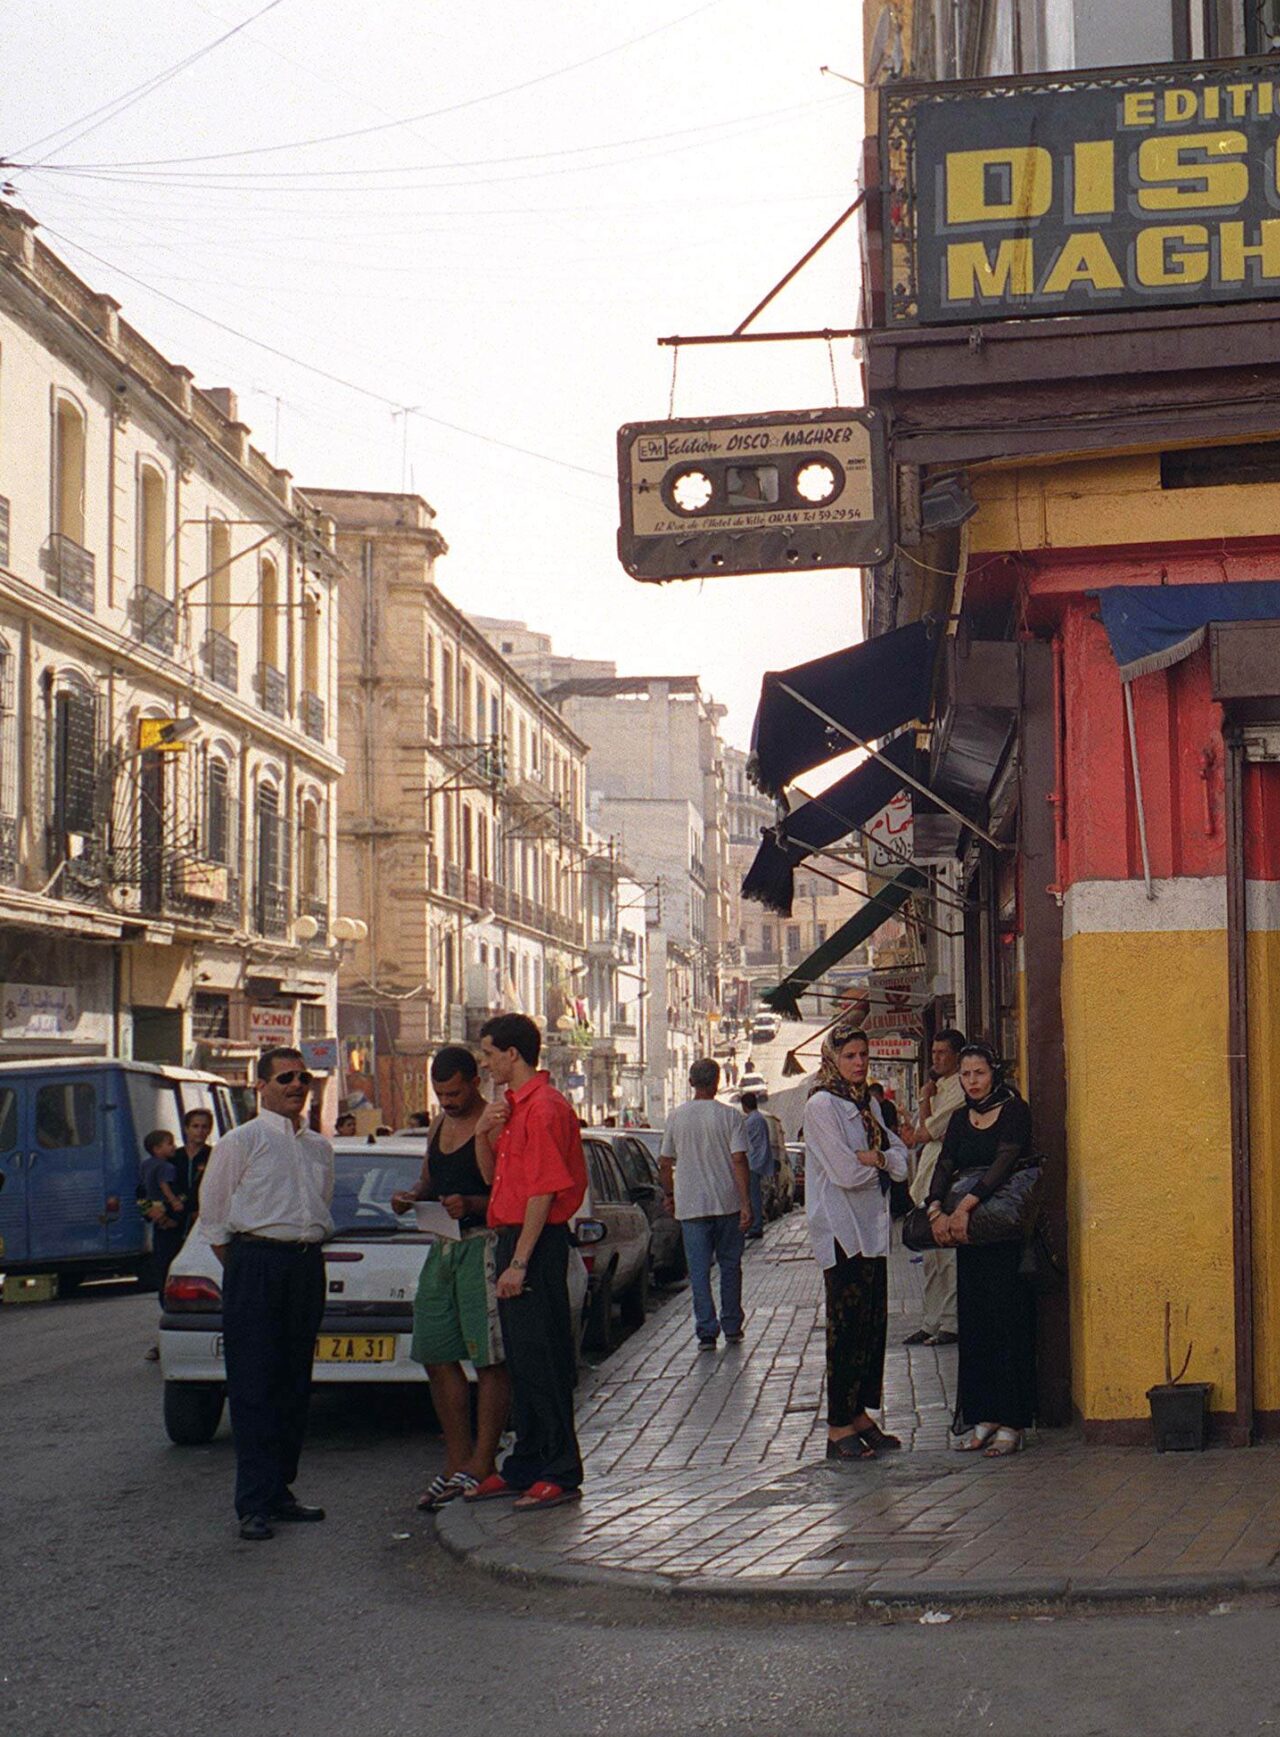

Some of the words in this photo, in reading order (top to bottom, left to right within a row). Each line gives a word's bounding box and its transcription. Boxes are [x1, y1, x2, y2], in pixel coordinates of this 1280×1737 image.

[727, 434, 769, 450] DISCO
[780, 426, 853, 447] MAGHREB
[768, 512, 799, 524] ORAN
[332, 1339, 354, 1357] ZA
[365, 1339, 384, 1357] 31
